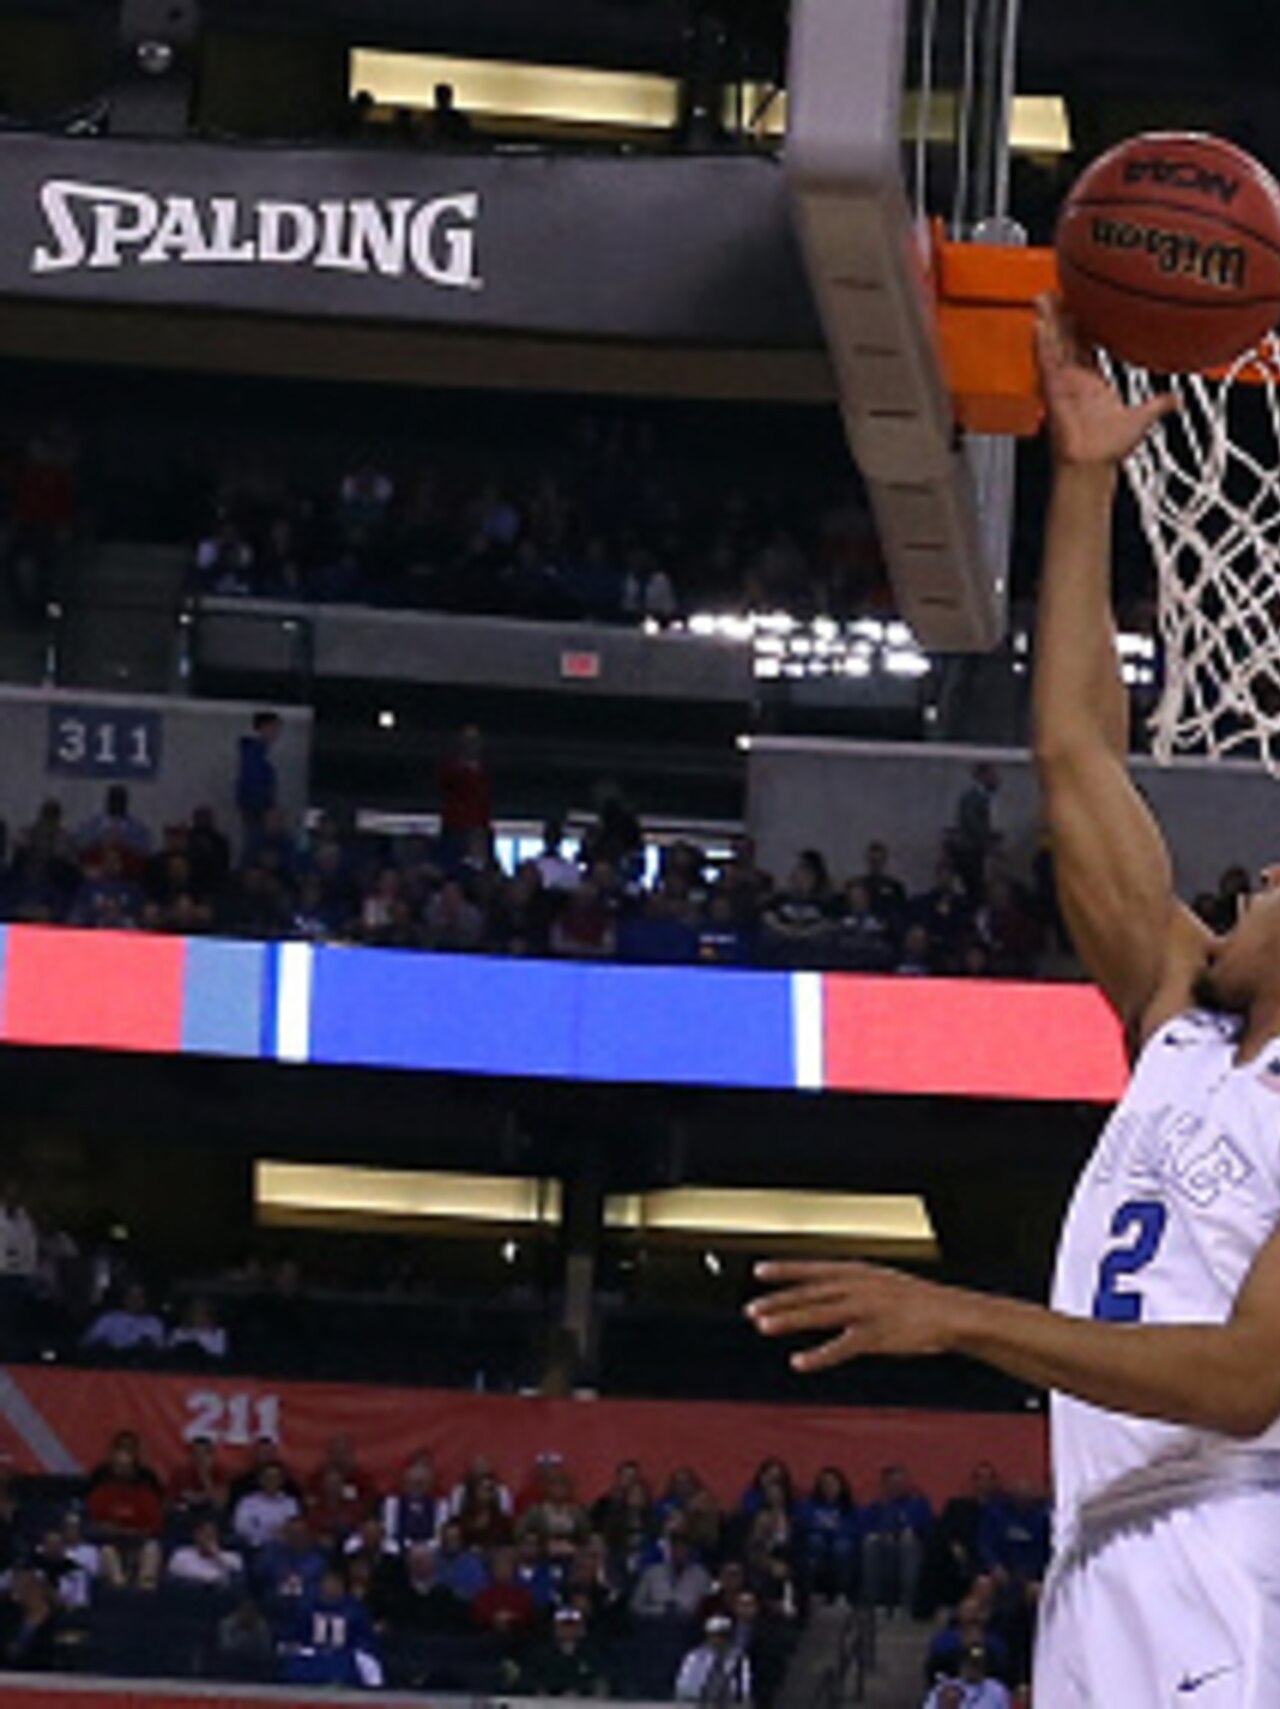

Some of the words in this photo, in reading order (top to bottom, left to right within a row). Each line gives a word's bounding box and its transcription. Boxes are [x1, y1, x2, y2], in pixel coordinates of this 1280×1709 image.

[31, 179, 479, 286] SPALDING
[1091, 216, 1248, 289] Wilson
[58, 717, 152, 768] 311
[1093, 1200, 1167, 1322] 2
[182, 1391, 280, 1445] 211
